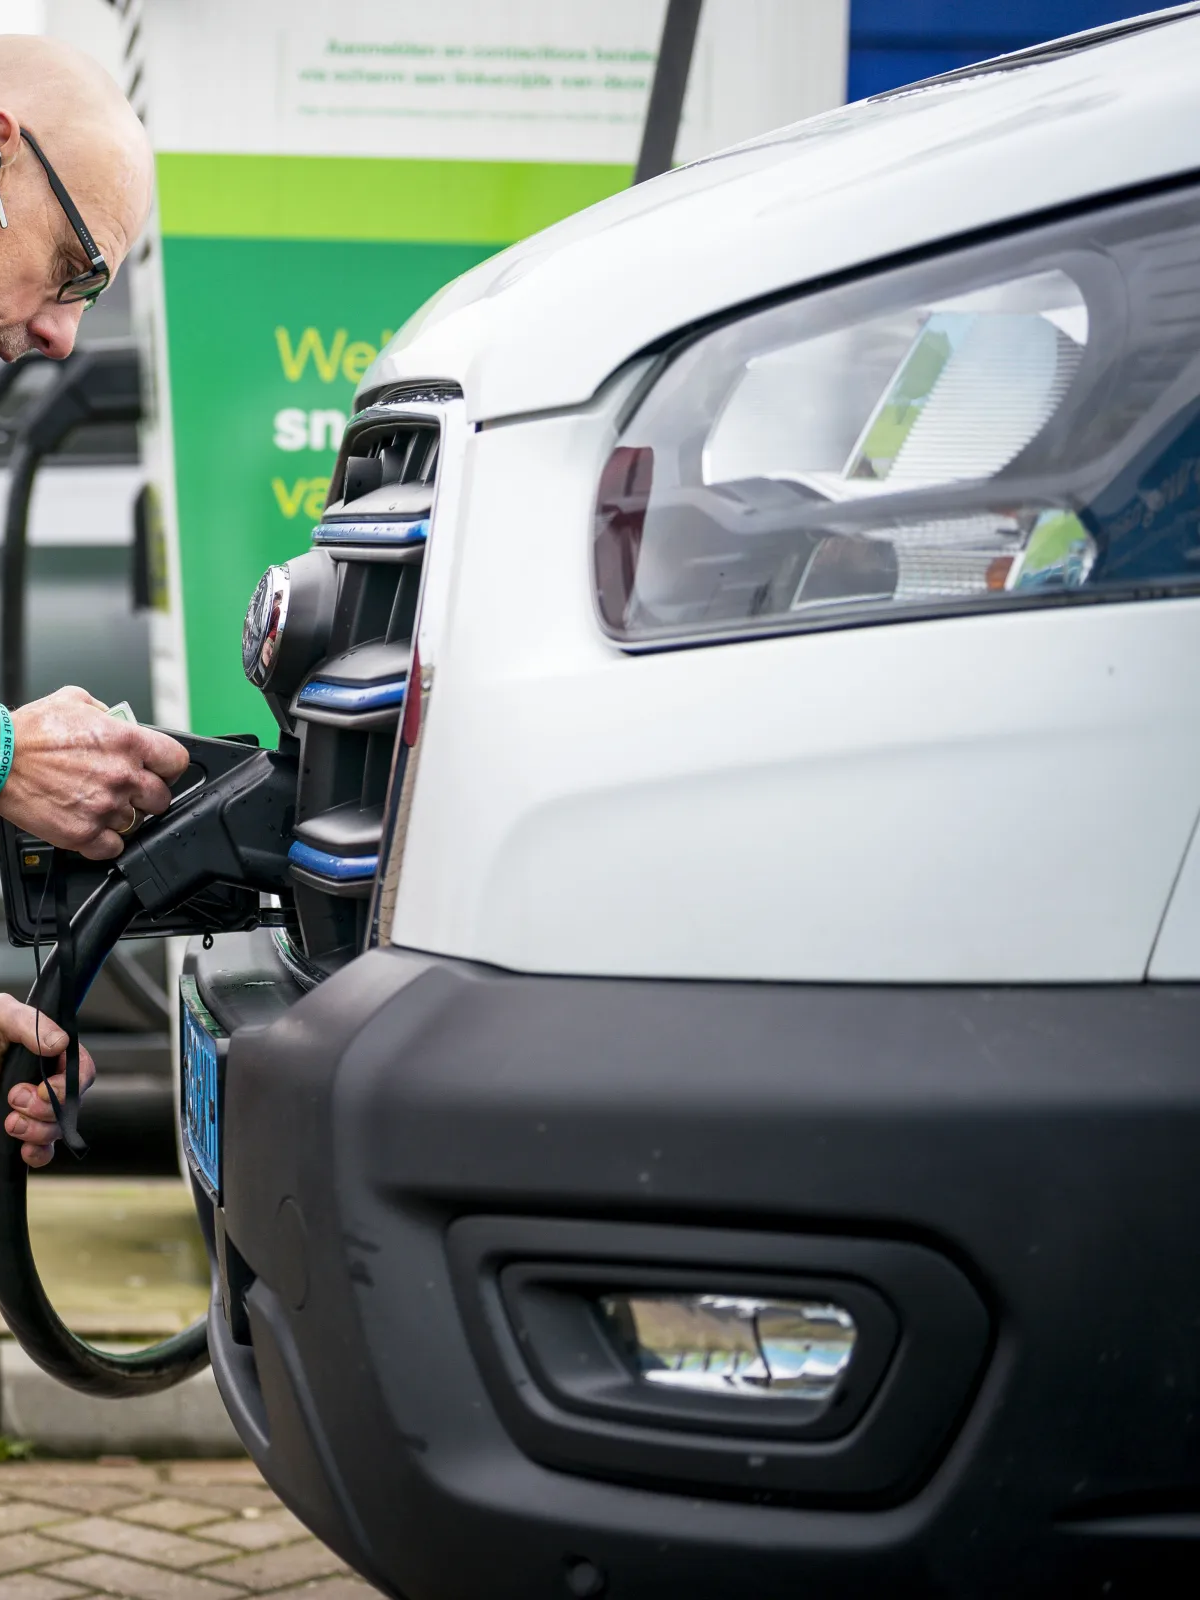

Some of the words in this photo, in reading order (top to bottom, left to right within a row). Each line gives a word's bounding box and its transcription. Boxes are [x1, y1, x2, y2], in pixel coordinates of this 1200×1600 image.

[273, 407, 347, 451] sn
[272, 477, 331, 519] va
[0, 709, 12, 735] GOLF
